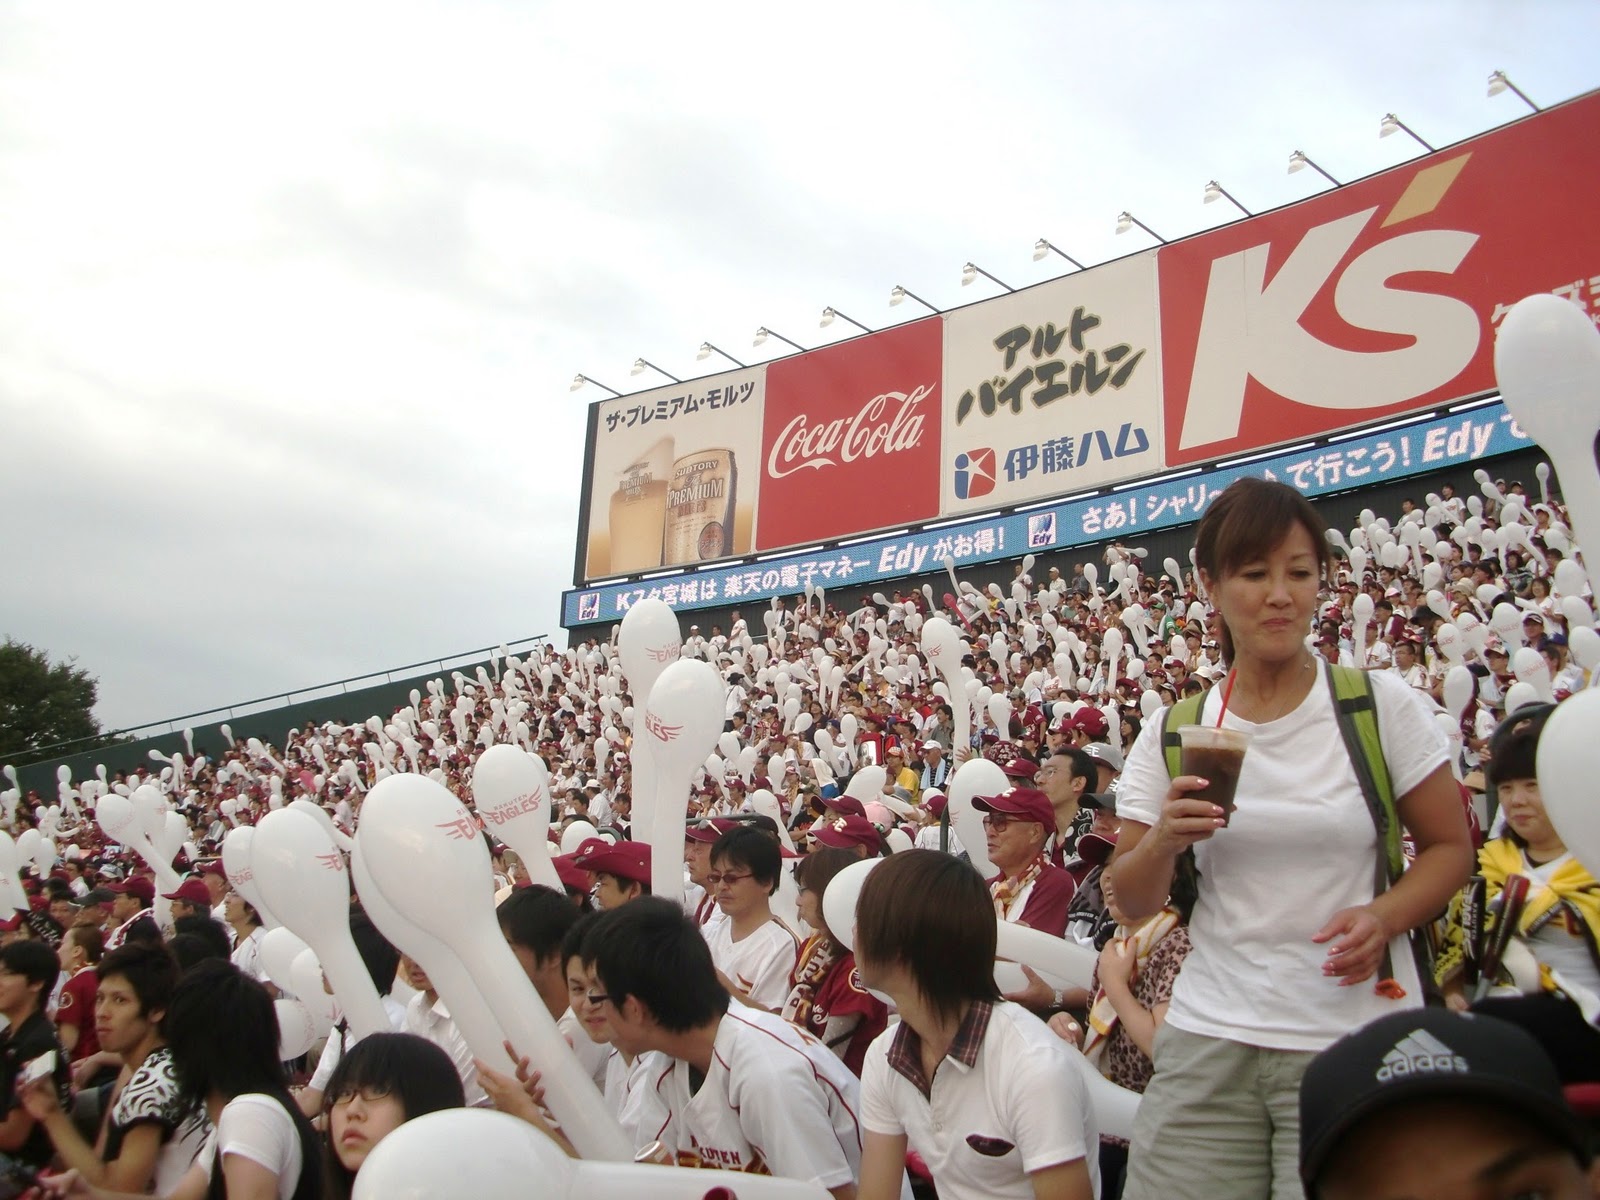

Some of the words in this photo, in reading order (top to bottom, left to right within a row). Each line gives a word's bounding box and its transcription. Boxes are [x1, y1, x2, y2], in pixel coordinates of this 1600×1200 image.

[993, 305, 1101, 371] アルト
[605, 381, 756, 433] ザ・プレミアム・モルツ
[955, 343, 1147, 427] バイエルン
[767, 381, 936, 479] Coca-Cola
[1003, 422, 1150, 482] 伊藤ハム
[666, 478, 724, 510] PREMIUM
[724, 556, 871, 598] 楽天の電子マネー
[878, 543, 929, 573] Edy
[1422, 420, 1495, 463] Edy
[1032, 533, 1052, 546] Edy
[485, 794, 541, 825] EAGLES
[1376, 1055, 1469, 1083] adidas
